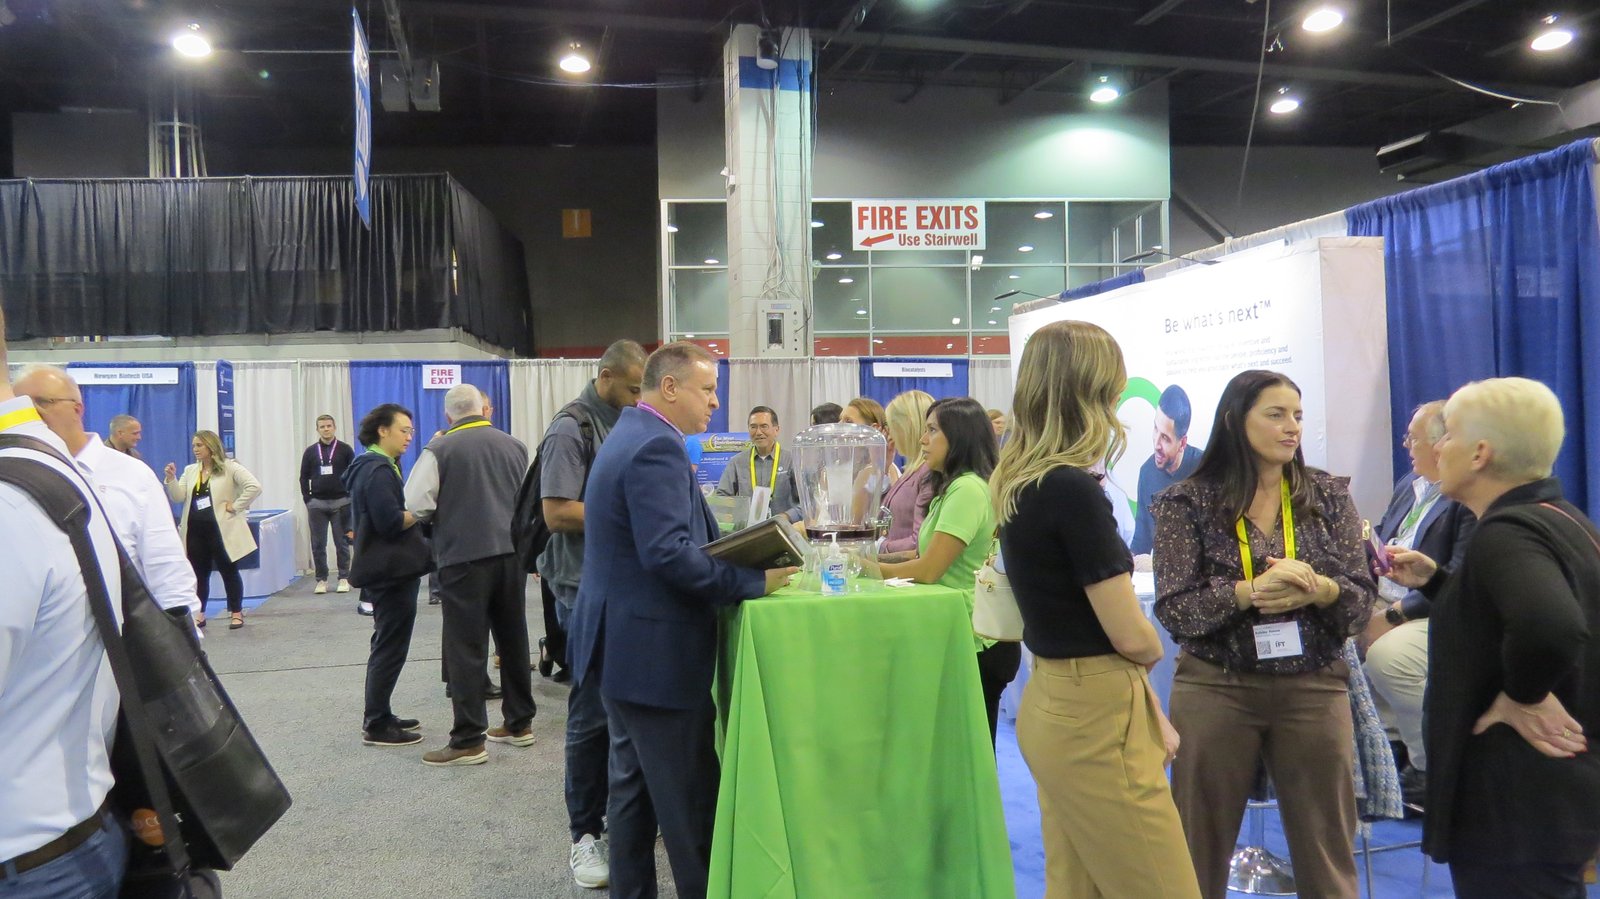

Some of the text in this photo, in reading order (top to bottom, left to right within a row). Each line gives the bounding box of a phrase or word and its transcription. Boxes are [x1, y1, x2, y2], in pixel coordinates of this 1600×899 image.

[857, 205, 979, 231] FIRE EXITS
[898, 232, 978, 247] Use Stairwell
[1164, 318, 1179, 334] Be
[1183, 309, 1224, 330] what's
[431, 377, 454, 385] EXIT
